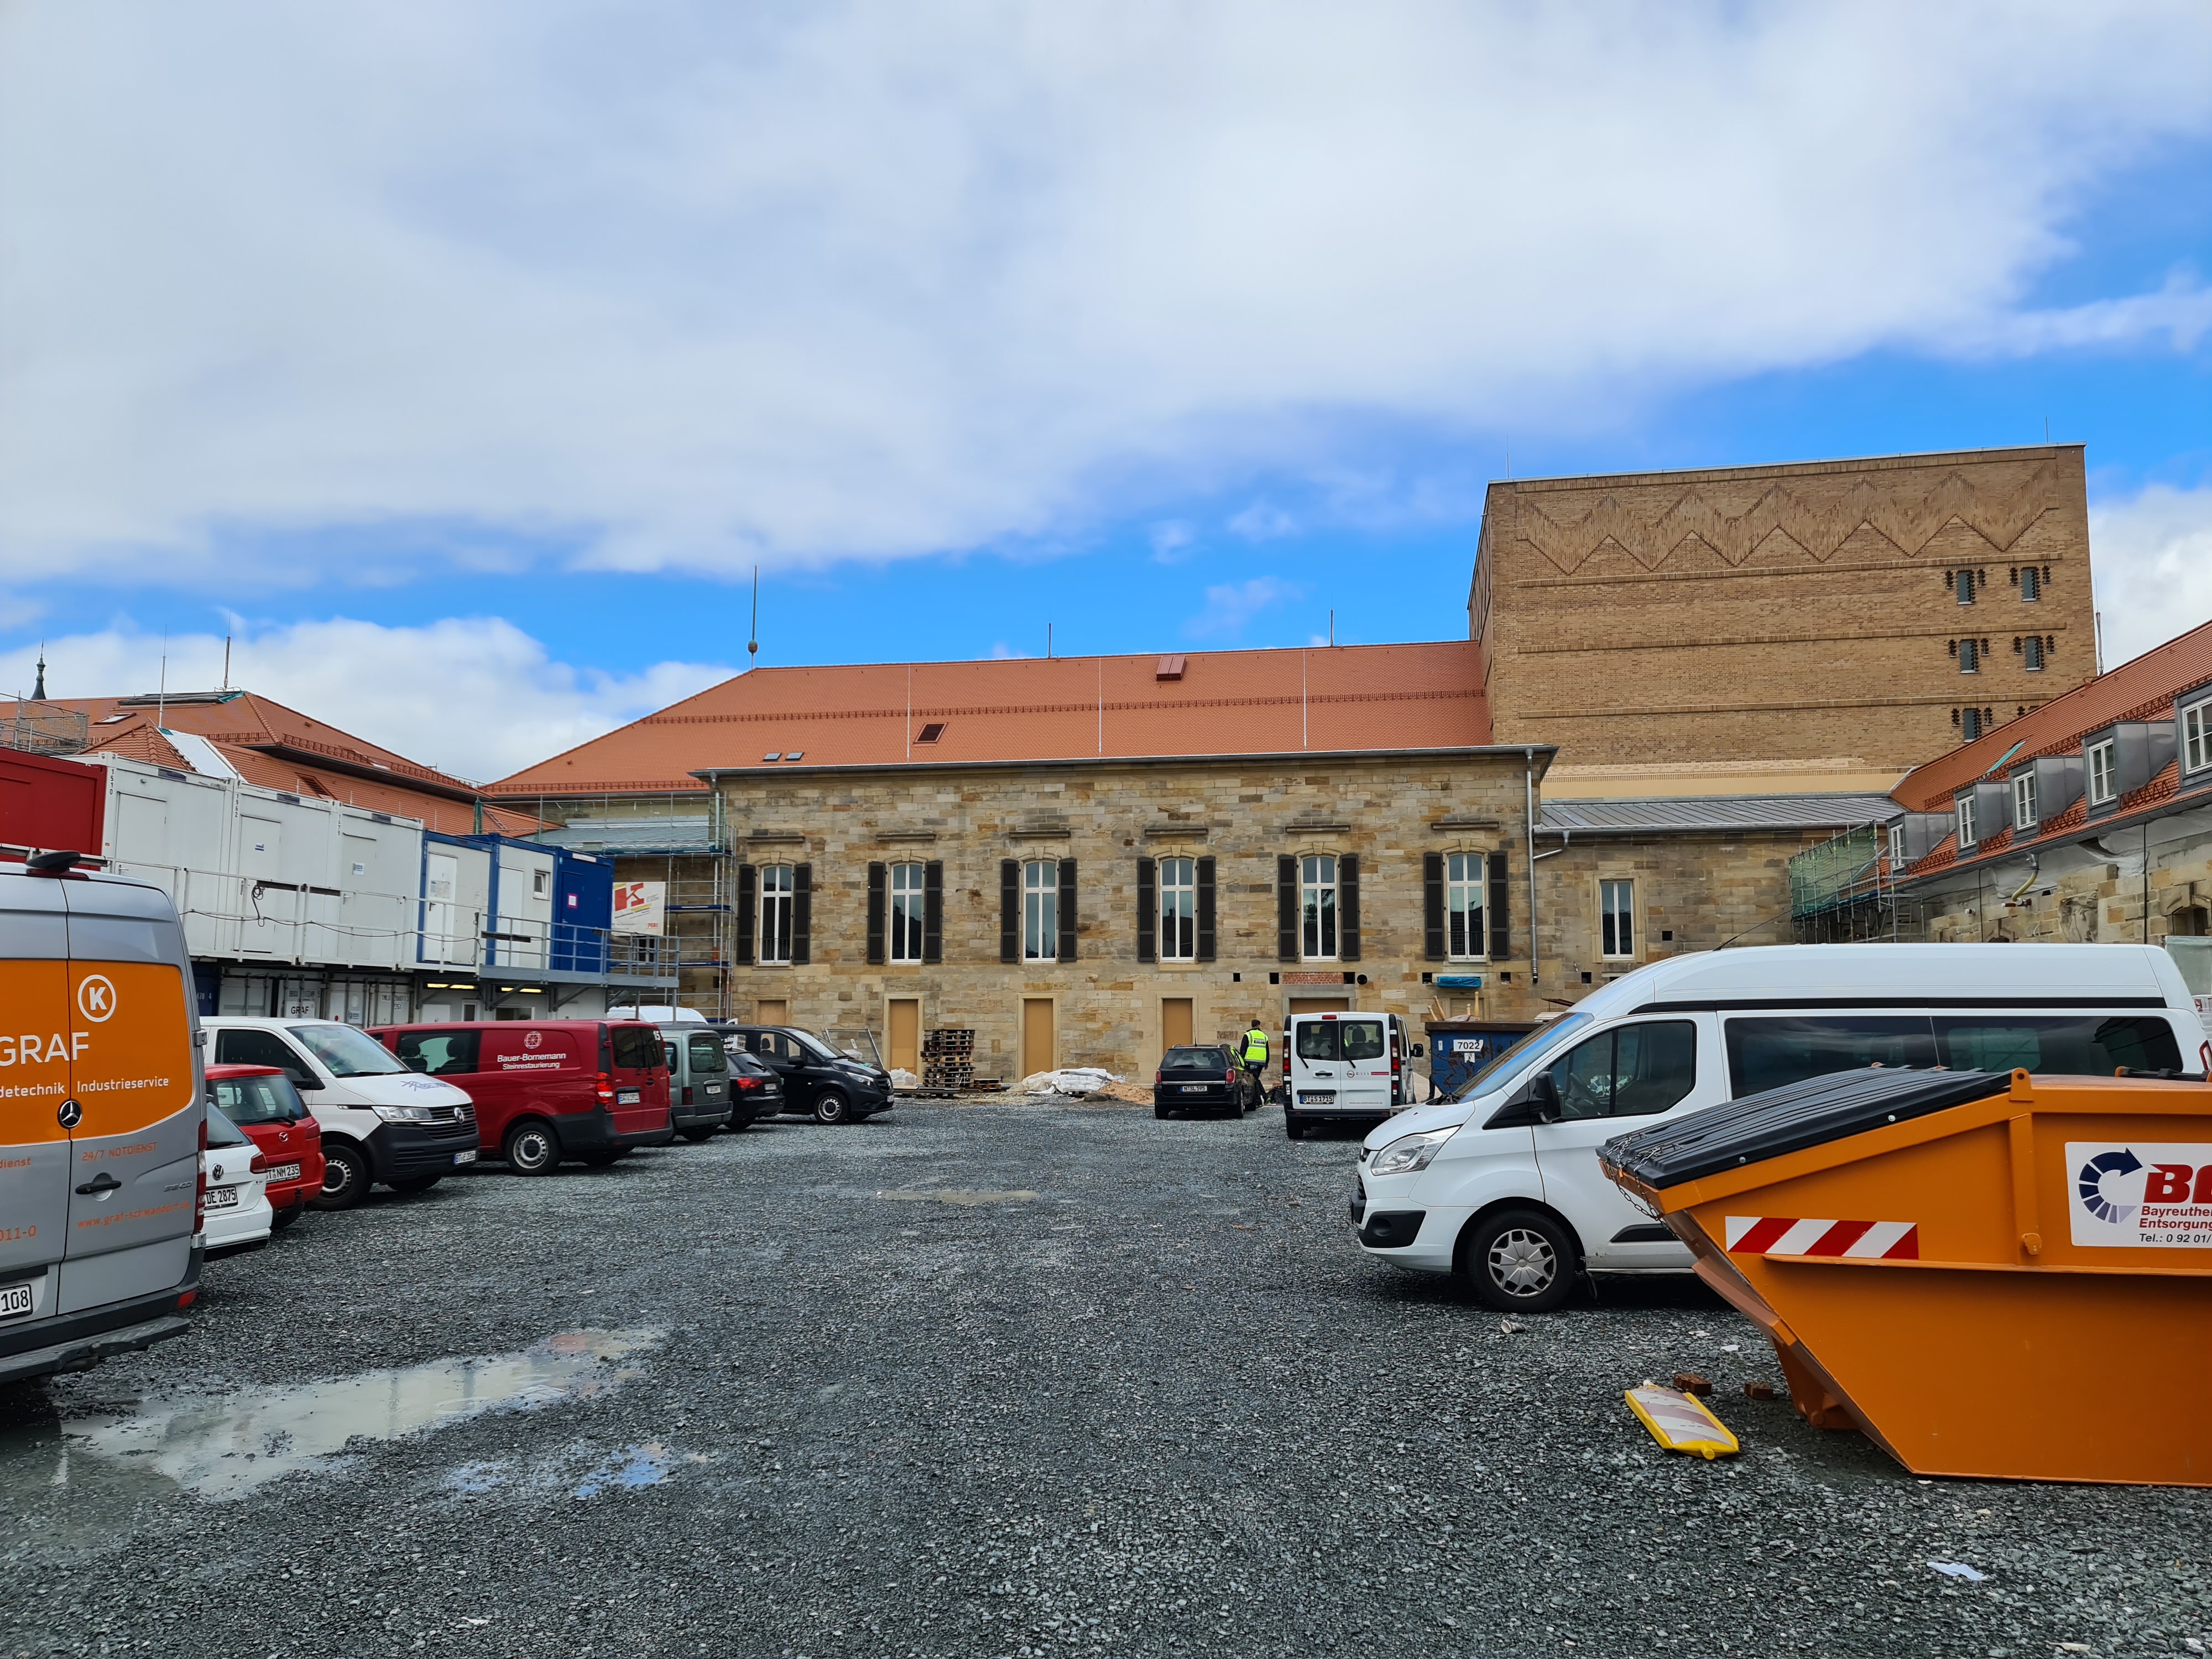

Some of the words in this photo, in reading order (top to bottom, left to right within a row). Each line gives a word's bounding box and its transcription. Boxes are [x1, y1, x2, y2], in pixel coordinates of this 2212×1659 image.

[89, 987, 106, 1010] K
[290, 1006, 310, 1014] GRAF
[653, 1030, 661, 1041] 15
[0, 1031, 89, 1067] GRAF
[497, 1053, 566, 1062] Bauer-Bornemann
[502, 1062, 560, 1070] Steinrestaurierung
[77, 1076, 169, 1093] Industrieservice
[82, 1150, 105, 1161] 24/7
[109, 1141, 158, 1157] NOTDIENST
[277, 1167, 286, 1178] NM
[287, 1165, 299, 1176] 235
[206, 1192, 217, 1204] DE
[218, 1189, 236, 1202] 2875
[77, 1201, 190, 1228] www.graf-schwandorf.de
[2141, 1206, 2212, 1218] Bayreuthe
[2139, 1233, 2163, 1243] Tel.:
[2166, 1234, 2173, 1243] 0
[2177, 1234, 2190, 1243] 92
[1, 1290, 29, 1312] 108
